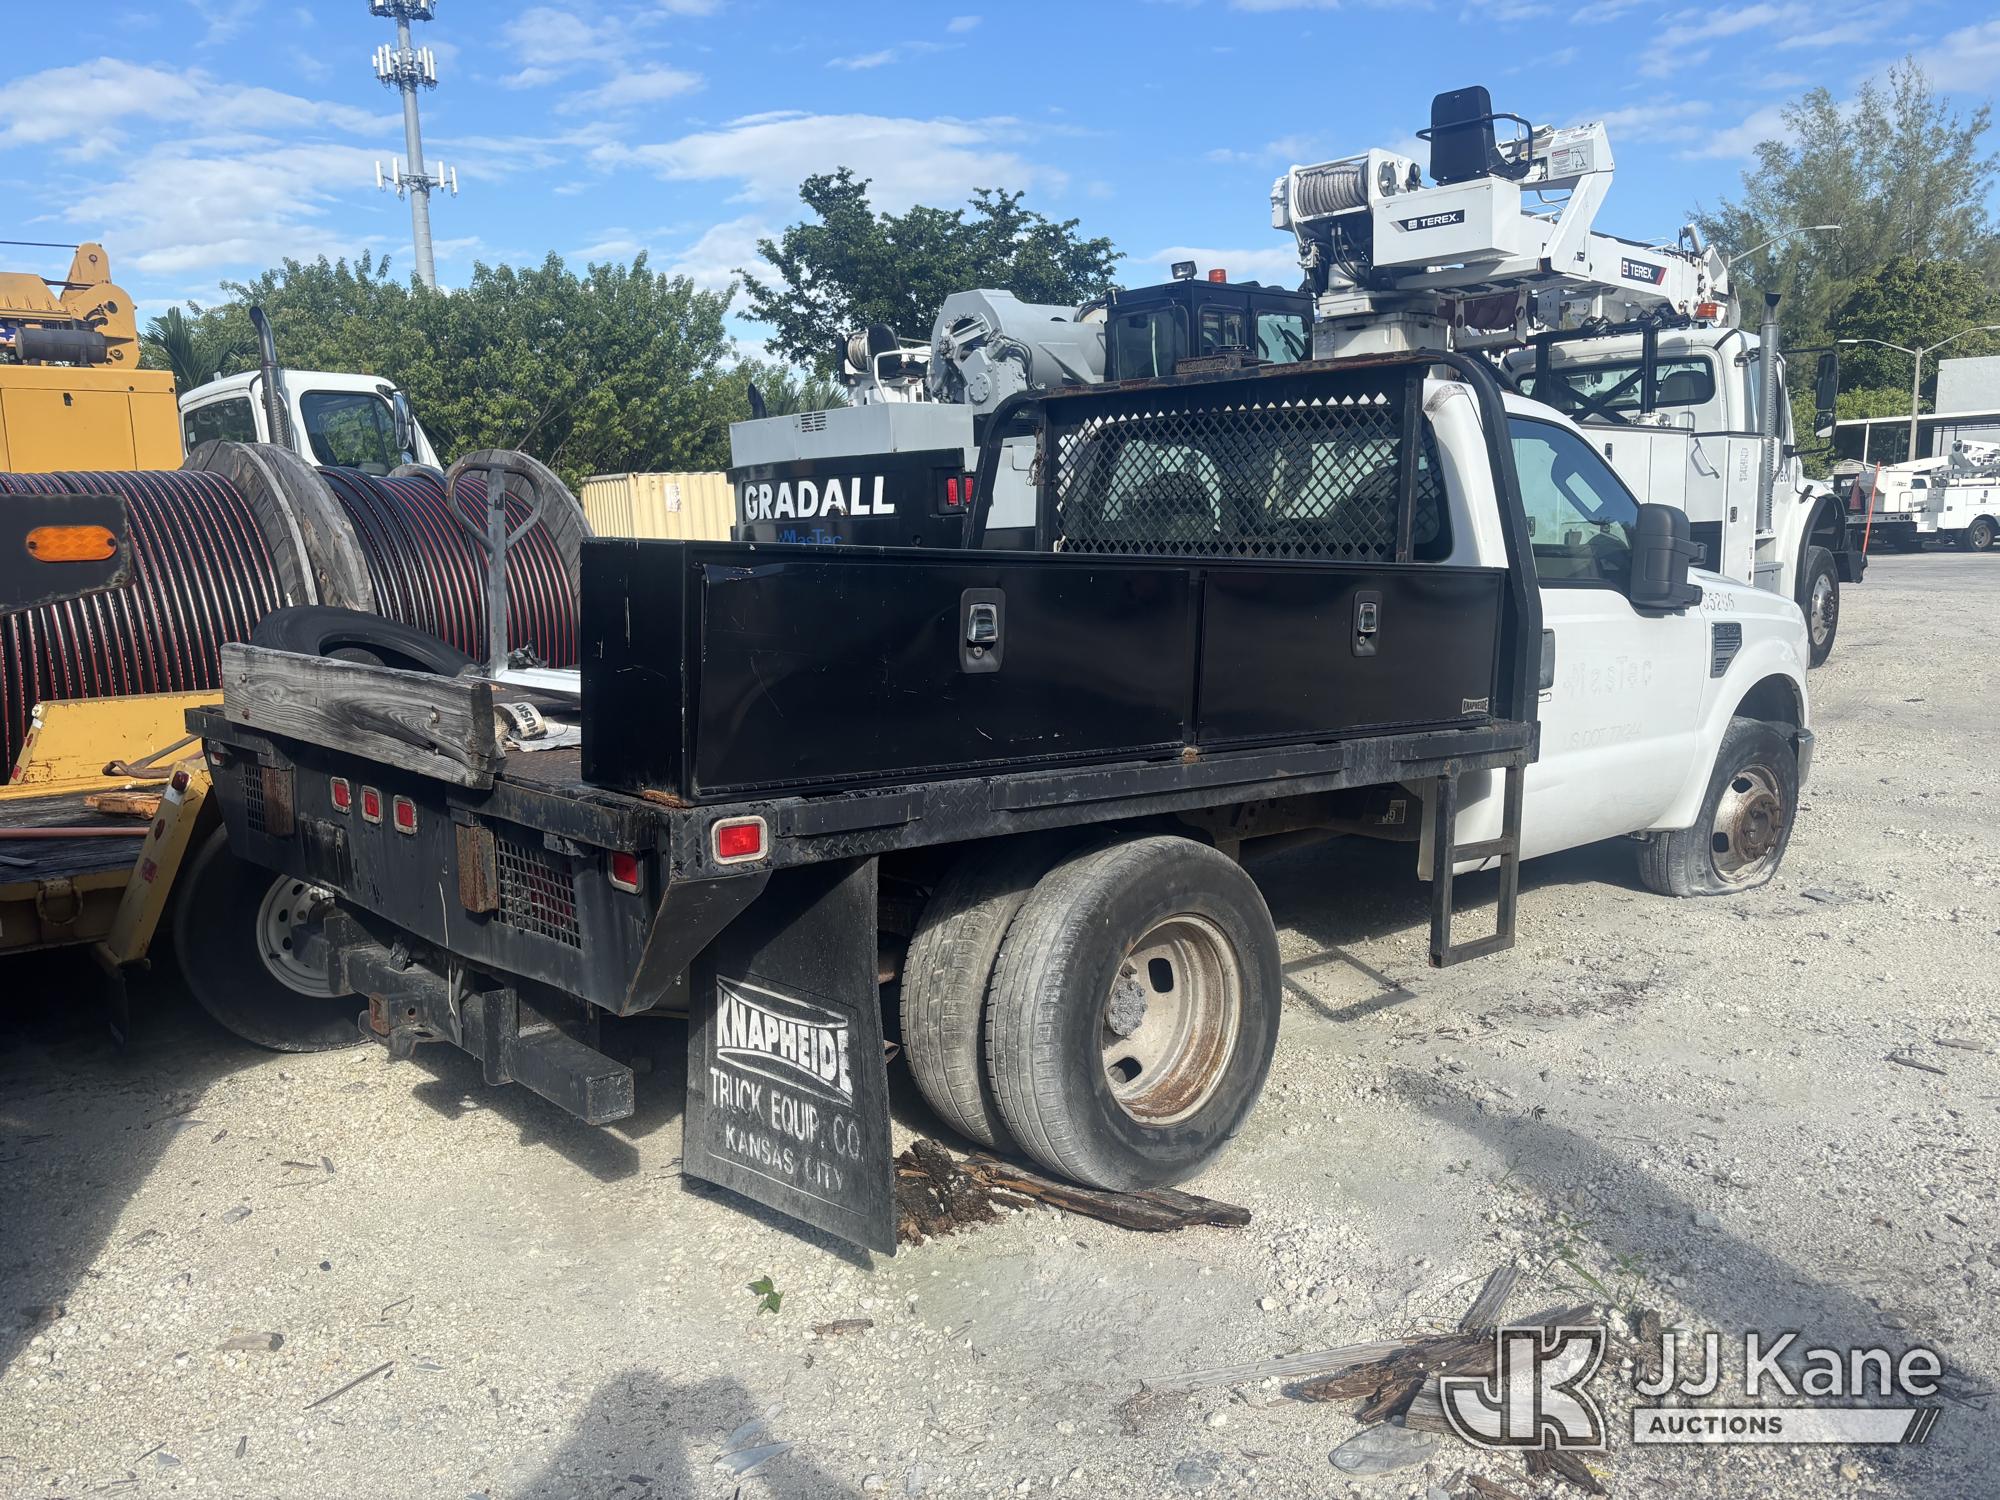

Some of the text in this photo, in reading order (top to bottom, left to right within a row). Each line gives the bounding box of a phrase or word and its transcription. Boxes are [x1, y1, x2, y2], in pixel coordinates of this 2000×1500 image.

[1420, 213, 1457, 227] TEREX
[1630, 263, 1653, 280] TEREX
[745, 476, 895, 521] GRADALL
[716, 990, 853, 1097] KNAPHEIDE
[709, 1066, 764, 1120] TRUCK
[726, 1125, 795, 1176] KANSAS
